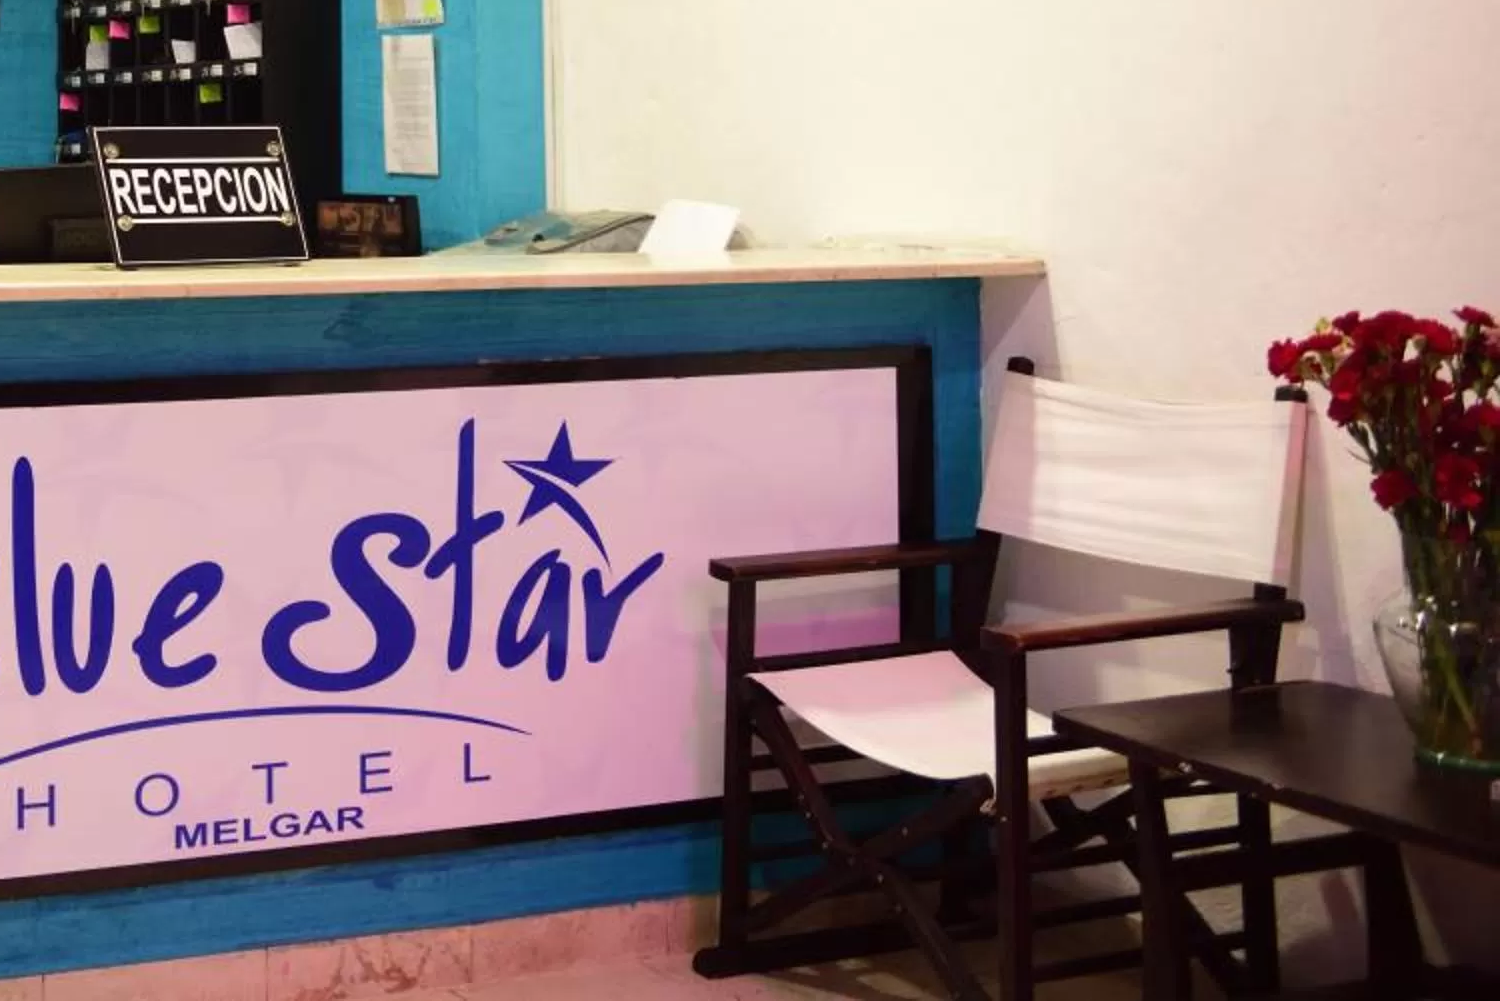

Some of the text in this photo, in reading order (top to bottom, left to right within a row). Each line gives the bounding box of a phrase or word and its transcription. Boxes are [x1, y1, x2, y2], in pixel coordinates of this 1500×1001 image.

[108, 167, 290, 215] RECEPCION
[261, 417, 664, 693] Star
[16, 743, 492, 831] HOTEL
[174, 805, 364, 850] MELGAR
